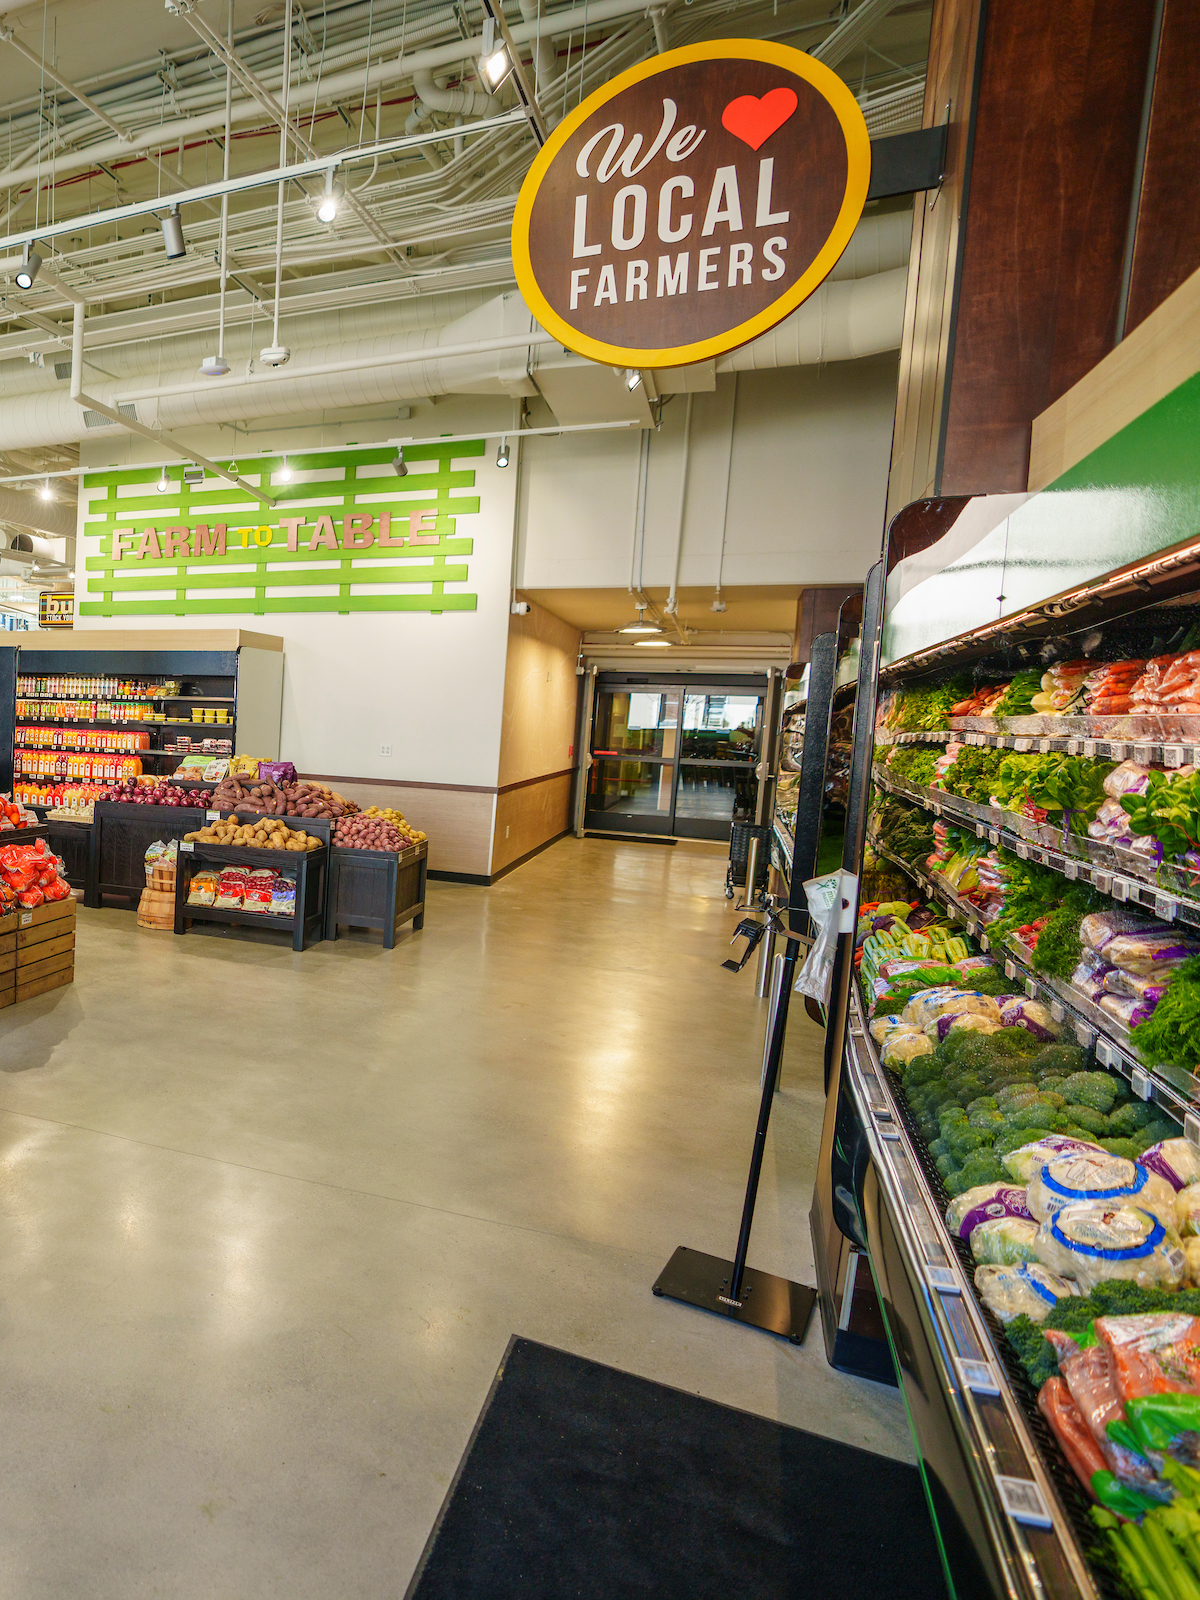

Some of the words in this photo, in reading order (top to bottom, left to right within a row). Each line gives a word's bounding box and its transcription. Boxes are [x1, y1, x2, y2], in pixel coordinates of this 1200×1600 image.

[575, 97, 707, 184] We
[572, 157, 790, 259] LOCAL
[569, 236, 788, 311] FARMERS
[112, 523, 228, 561] FARM
[237, 525, 274, 549] TO
[278, 508, 440, 553] TABLE
